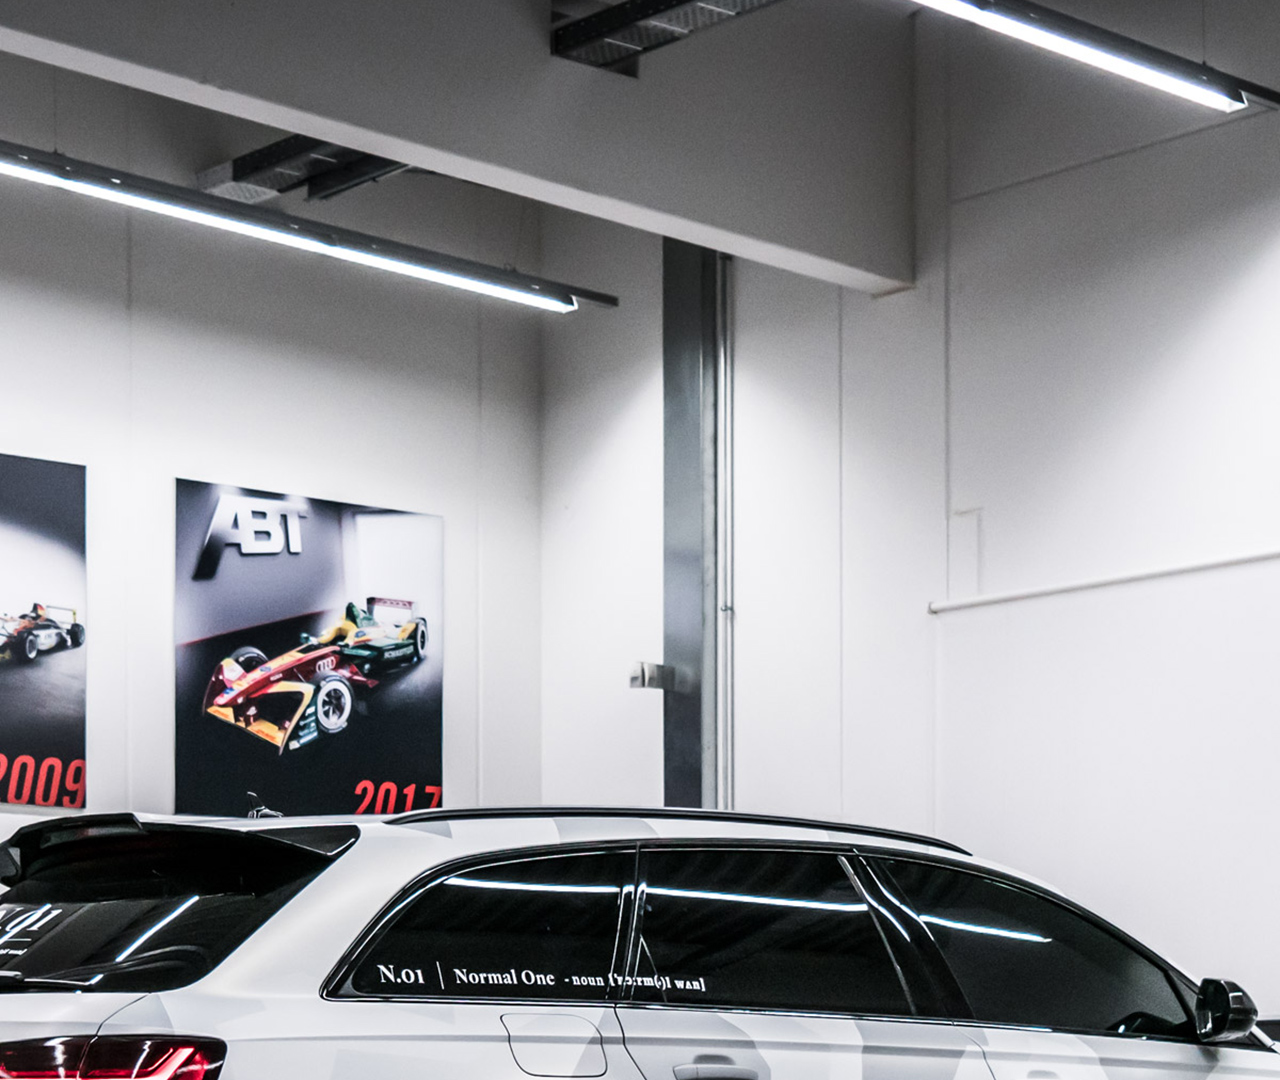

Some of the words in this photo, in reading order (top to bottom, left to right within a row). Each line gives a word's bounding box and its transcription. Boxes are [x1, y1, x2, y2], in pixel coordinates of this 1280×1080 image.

[191, 488, 310, 581] ABT
[354, 779, 442, 815] 2017
[377, 964, 425, 984] N.01
[453, 968, 518, 985] Normal
[521, 969, 556, 985] One
[571, 974, 605, 987] noun
